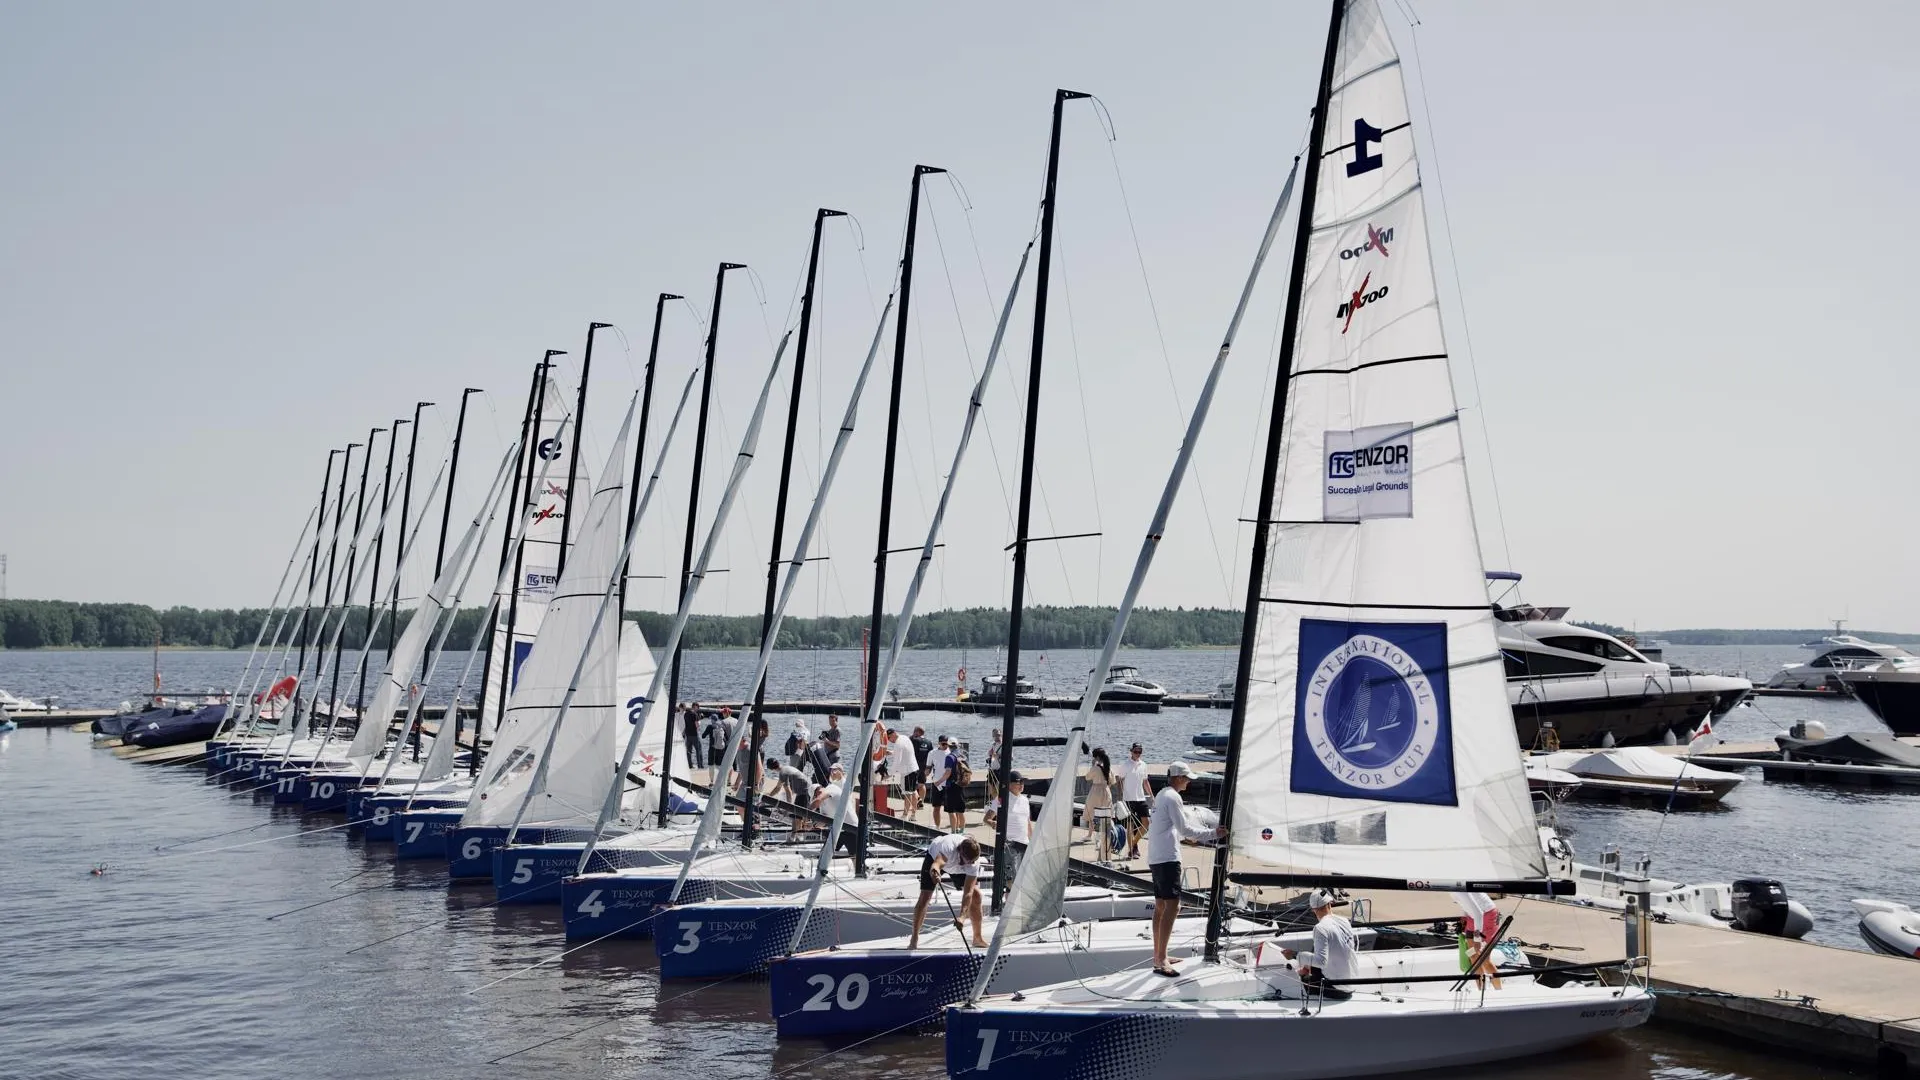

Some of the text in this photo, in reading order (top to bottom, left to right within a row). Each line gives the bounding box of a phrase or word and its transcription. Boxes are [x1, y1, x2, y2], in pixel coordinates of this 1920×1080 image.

[1354, 445, 1409, 468] ENZOR
[1375, 481, 1409, 490] Grounds
[1317, 738, 1424, 785] TENZOR CUP
[277, 777, 296, 793] 11
[310, 782, 335, 799] 10
[372, 806, 390, 826] 8
[405, 821, 425, 844] 7
[462, 837, 483, 860] 6
[511, 858, 534, 884] 5
[577, 889, 655, 917] 4 TENZOR
[672, 921, 758, 954] 3 TENZOR
[802, 972, 934, 1012] 20 TENZOR
[975, 1028, 1073, 1071] 1 TENZOR
